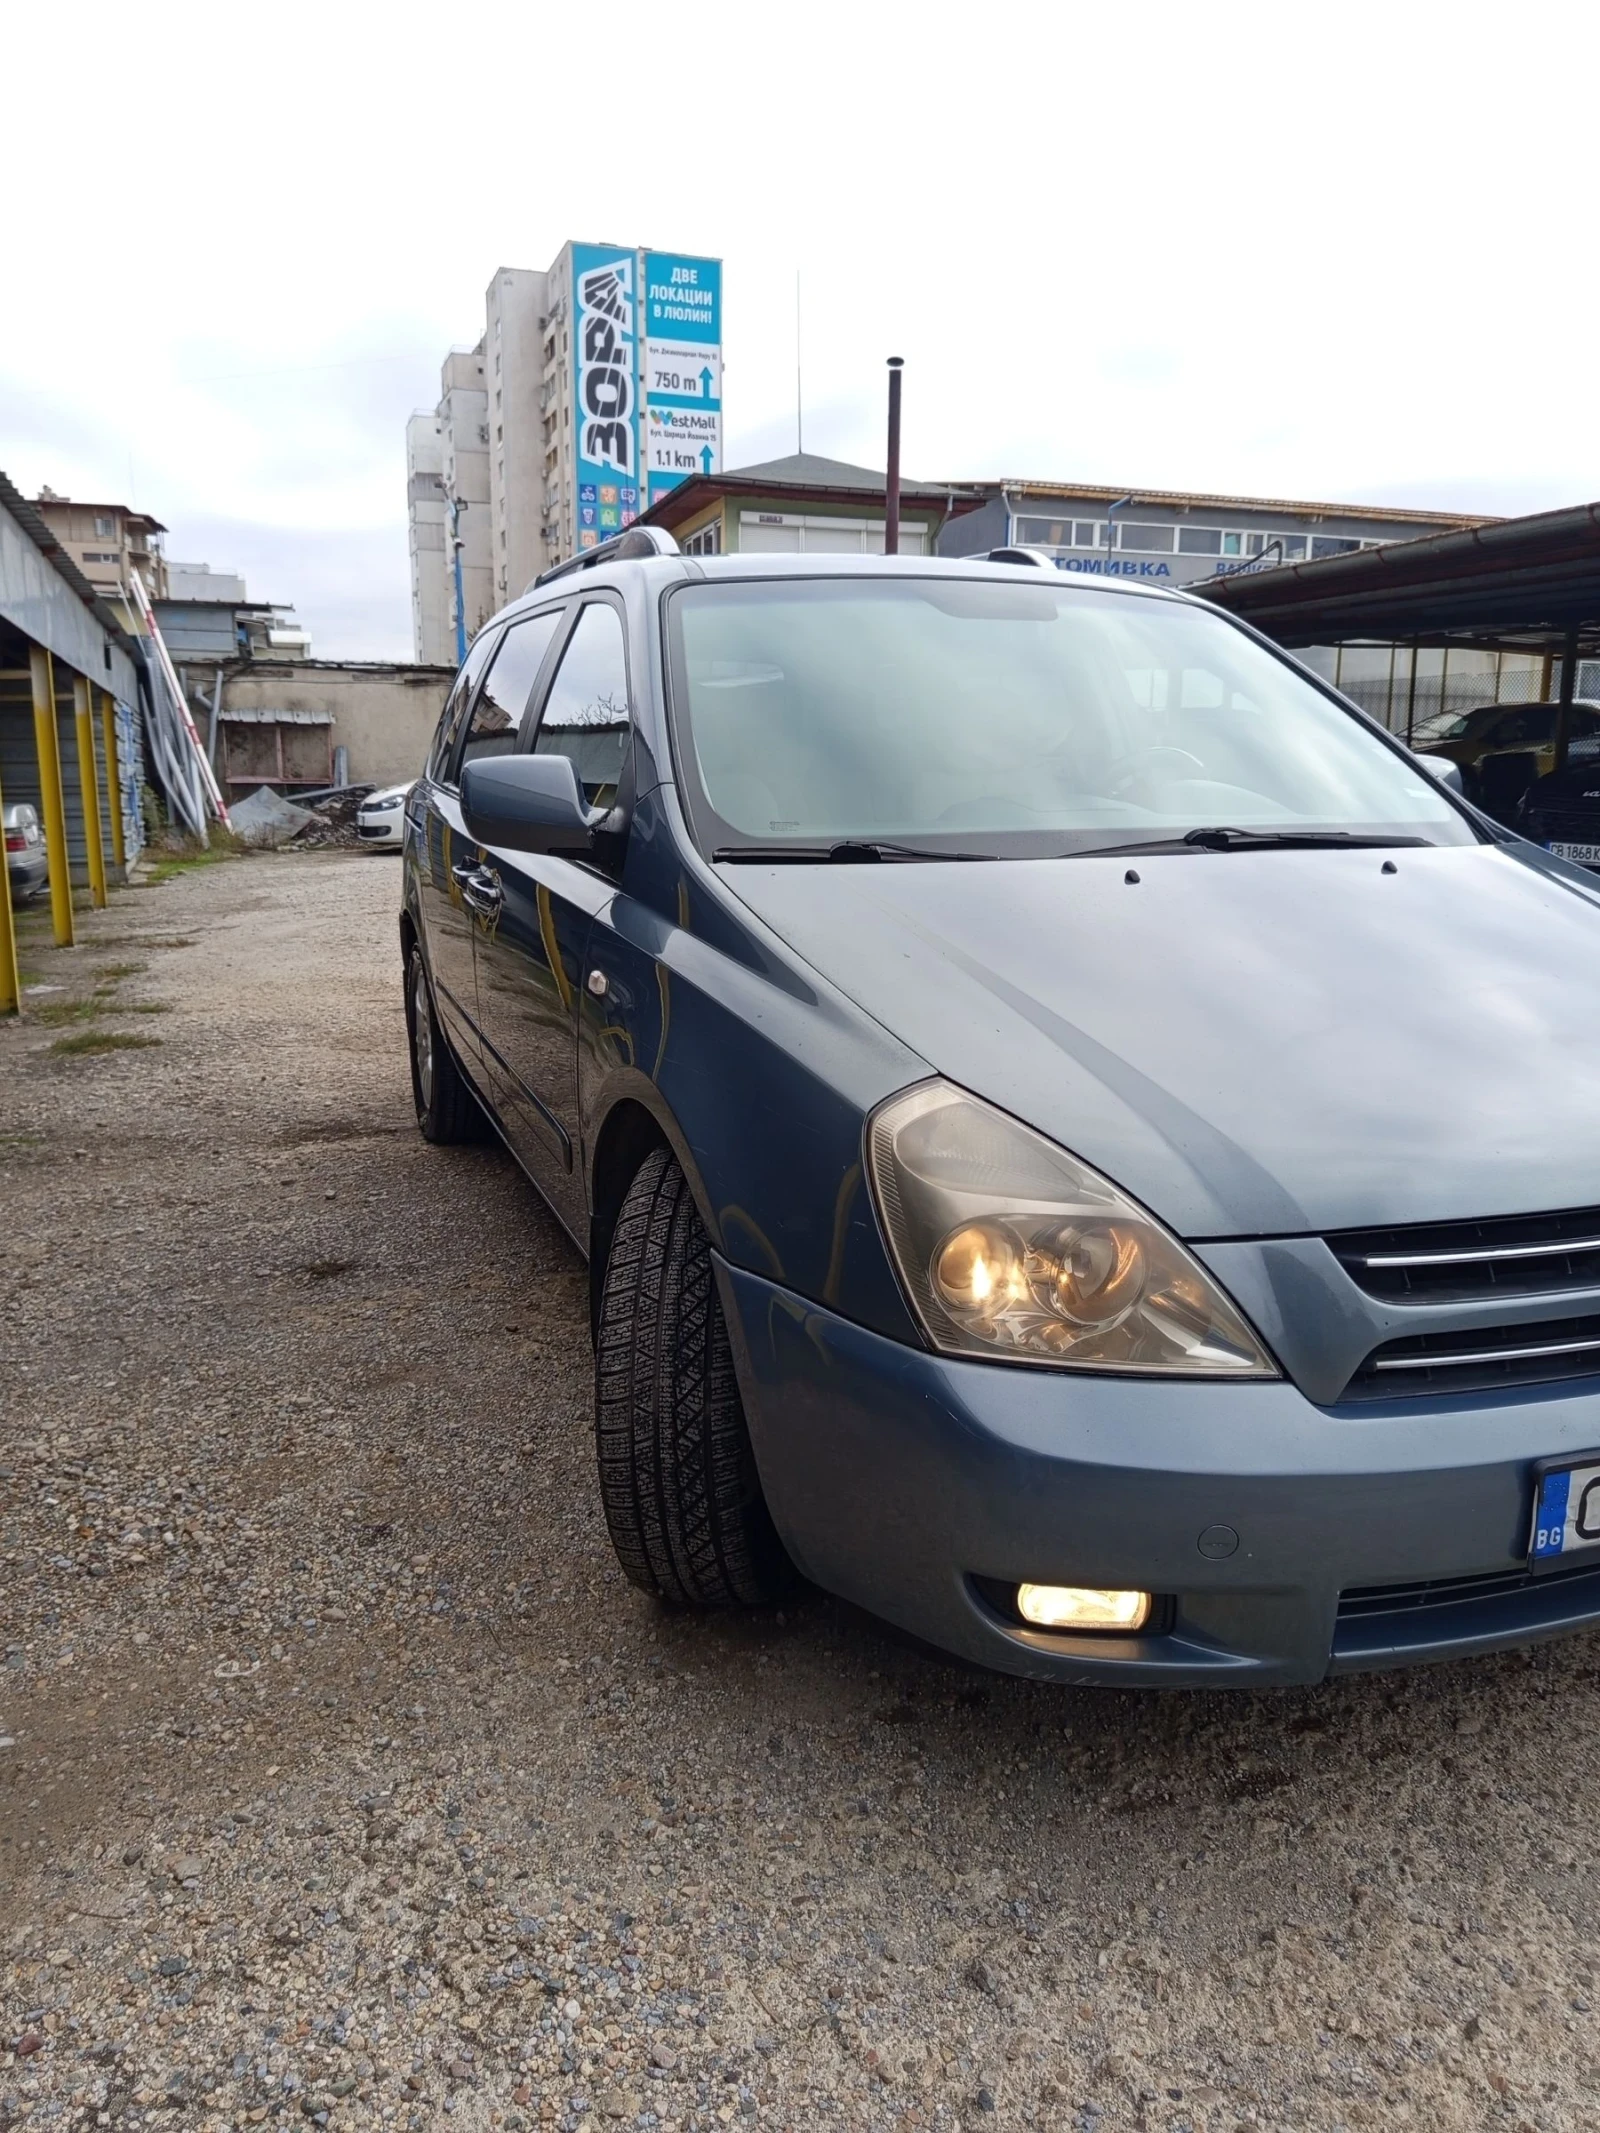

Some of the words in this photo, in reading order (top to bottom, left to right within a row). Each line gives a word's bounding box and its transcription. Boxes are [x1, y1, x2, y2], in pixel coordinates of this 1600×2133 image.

[671, 267, 698, 285] ДВЕ
[649, 285, 713, 306] ЛОКАЦИИ
[653, 304, 662, 318] В
[664, 305, 712, 324] ЛЮЛИН!
[655, 370, 680, 389] 750
[683, 377, 697, 391] m
[650, 409, 716, 429] WestMall
[656, 449, 671, 467] 1.1
[675, 450, 696, 468] km
[1567, 845, 1592, 860] 1868
[1536, 1526, 1562, 1550] BG
